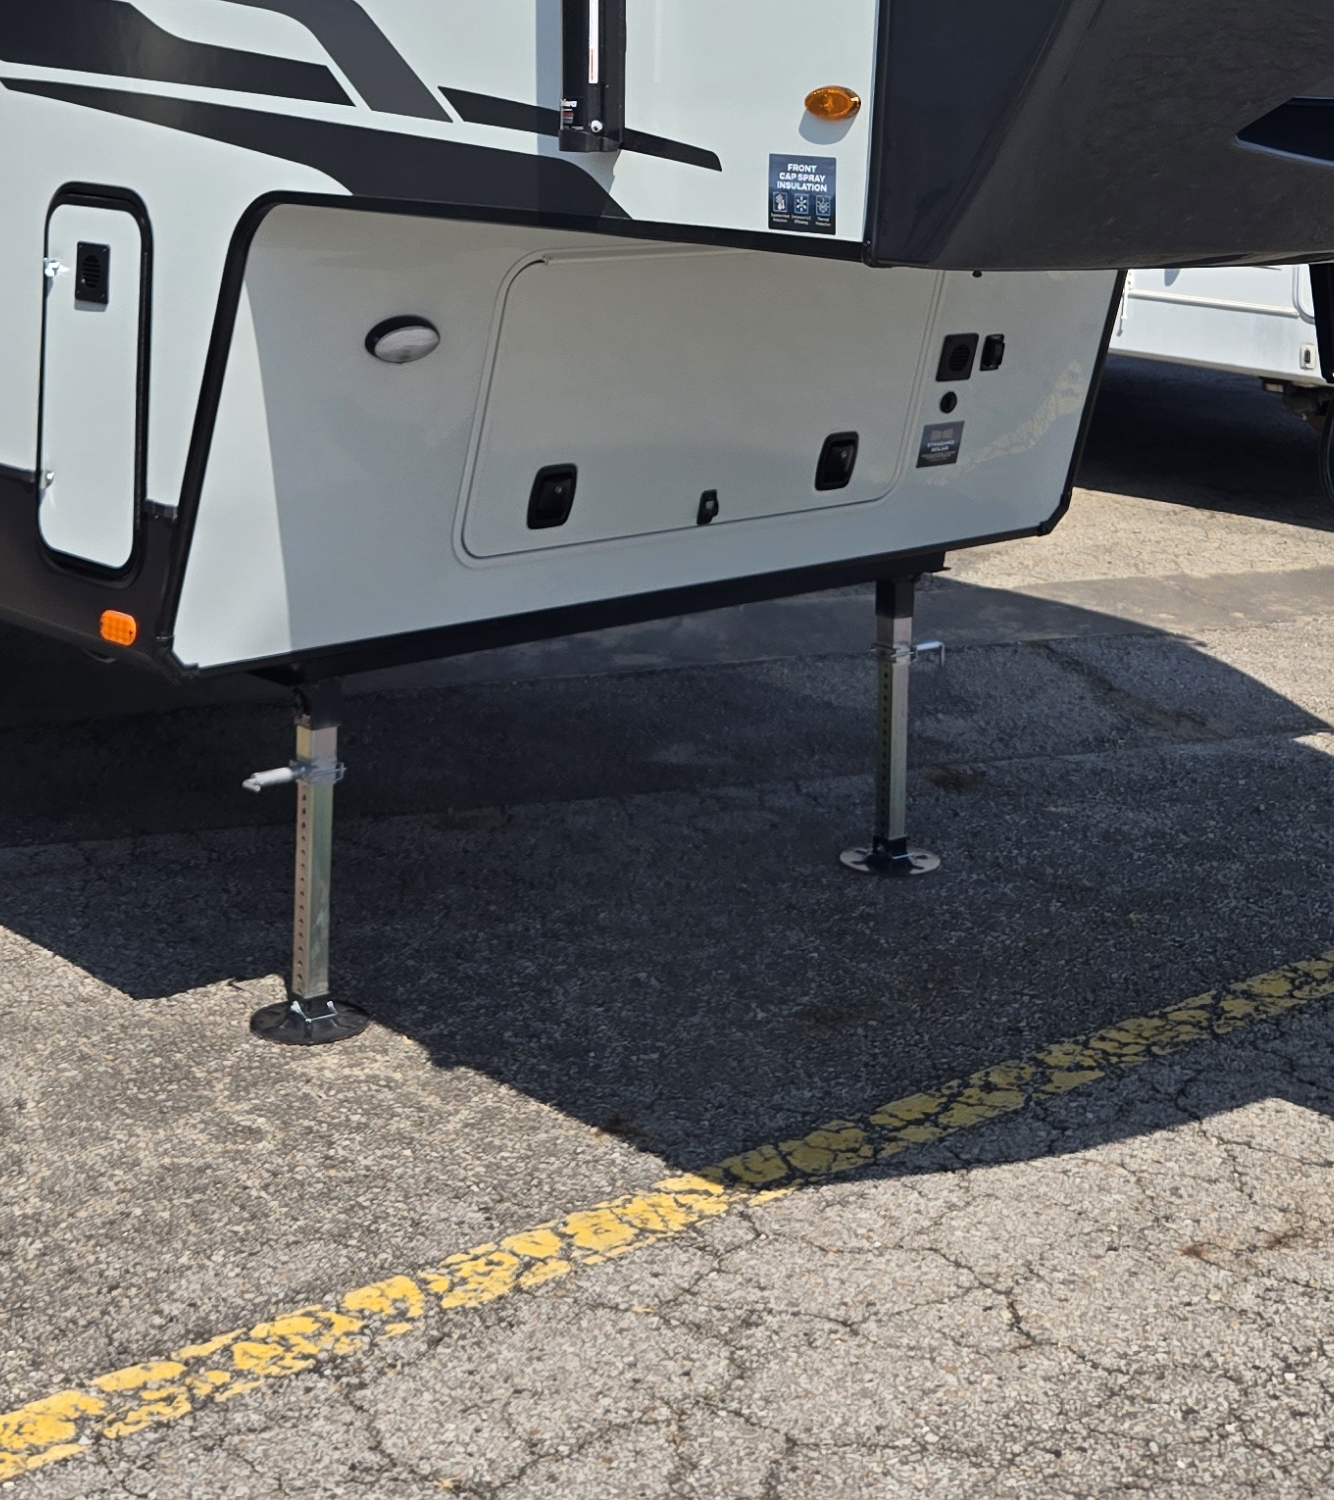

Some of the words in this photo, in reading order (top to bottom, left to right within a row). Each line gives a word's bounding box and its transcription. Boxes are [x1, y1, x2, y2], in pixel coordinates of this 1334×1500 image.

[787, 163, 817, 173] FRONT
[779, 172, 797, 181] CAP
[797, 173, 826, 183] SPRAY
[776, 180, 827, 192] INSULATION
